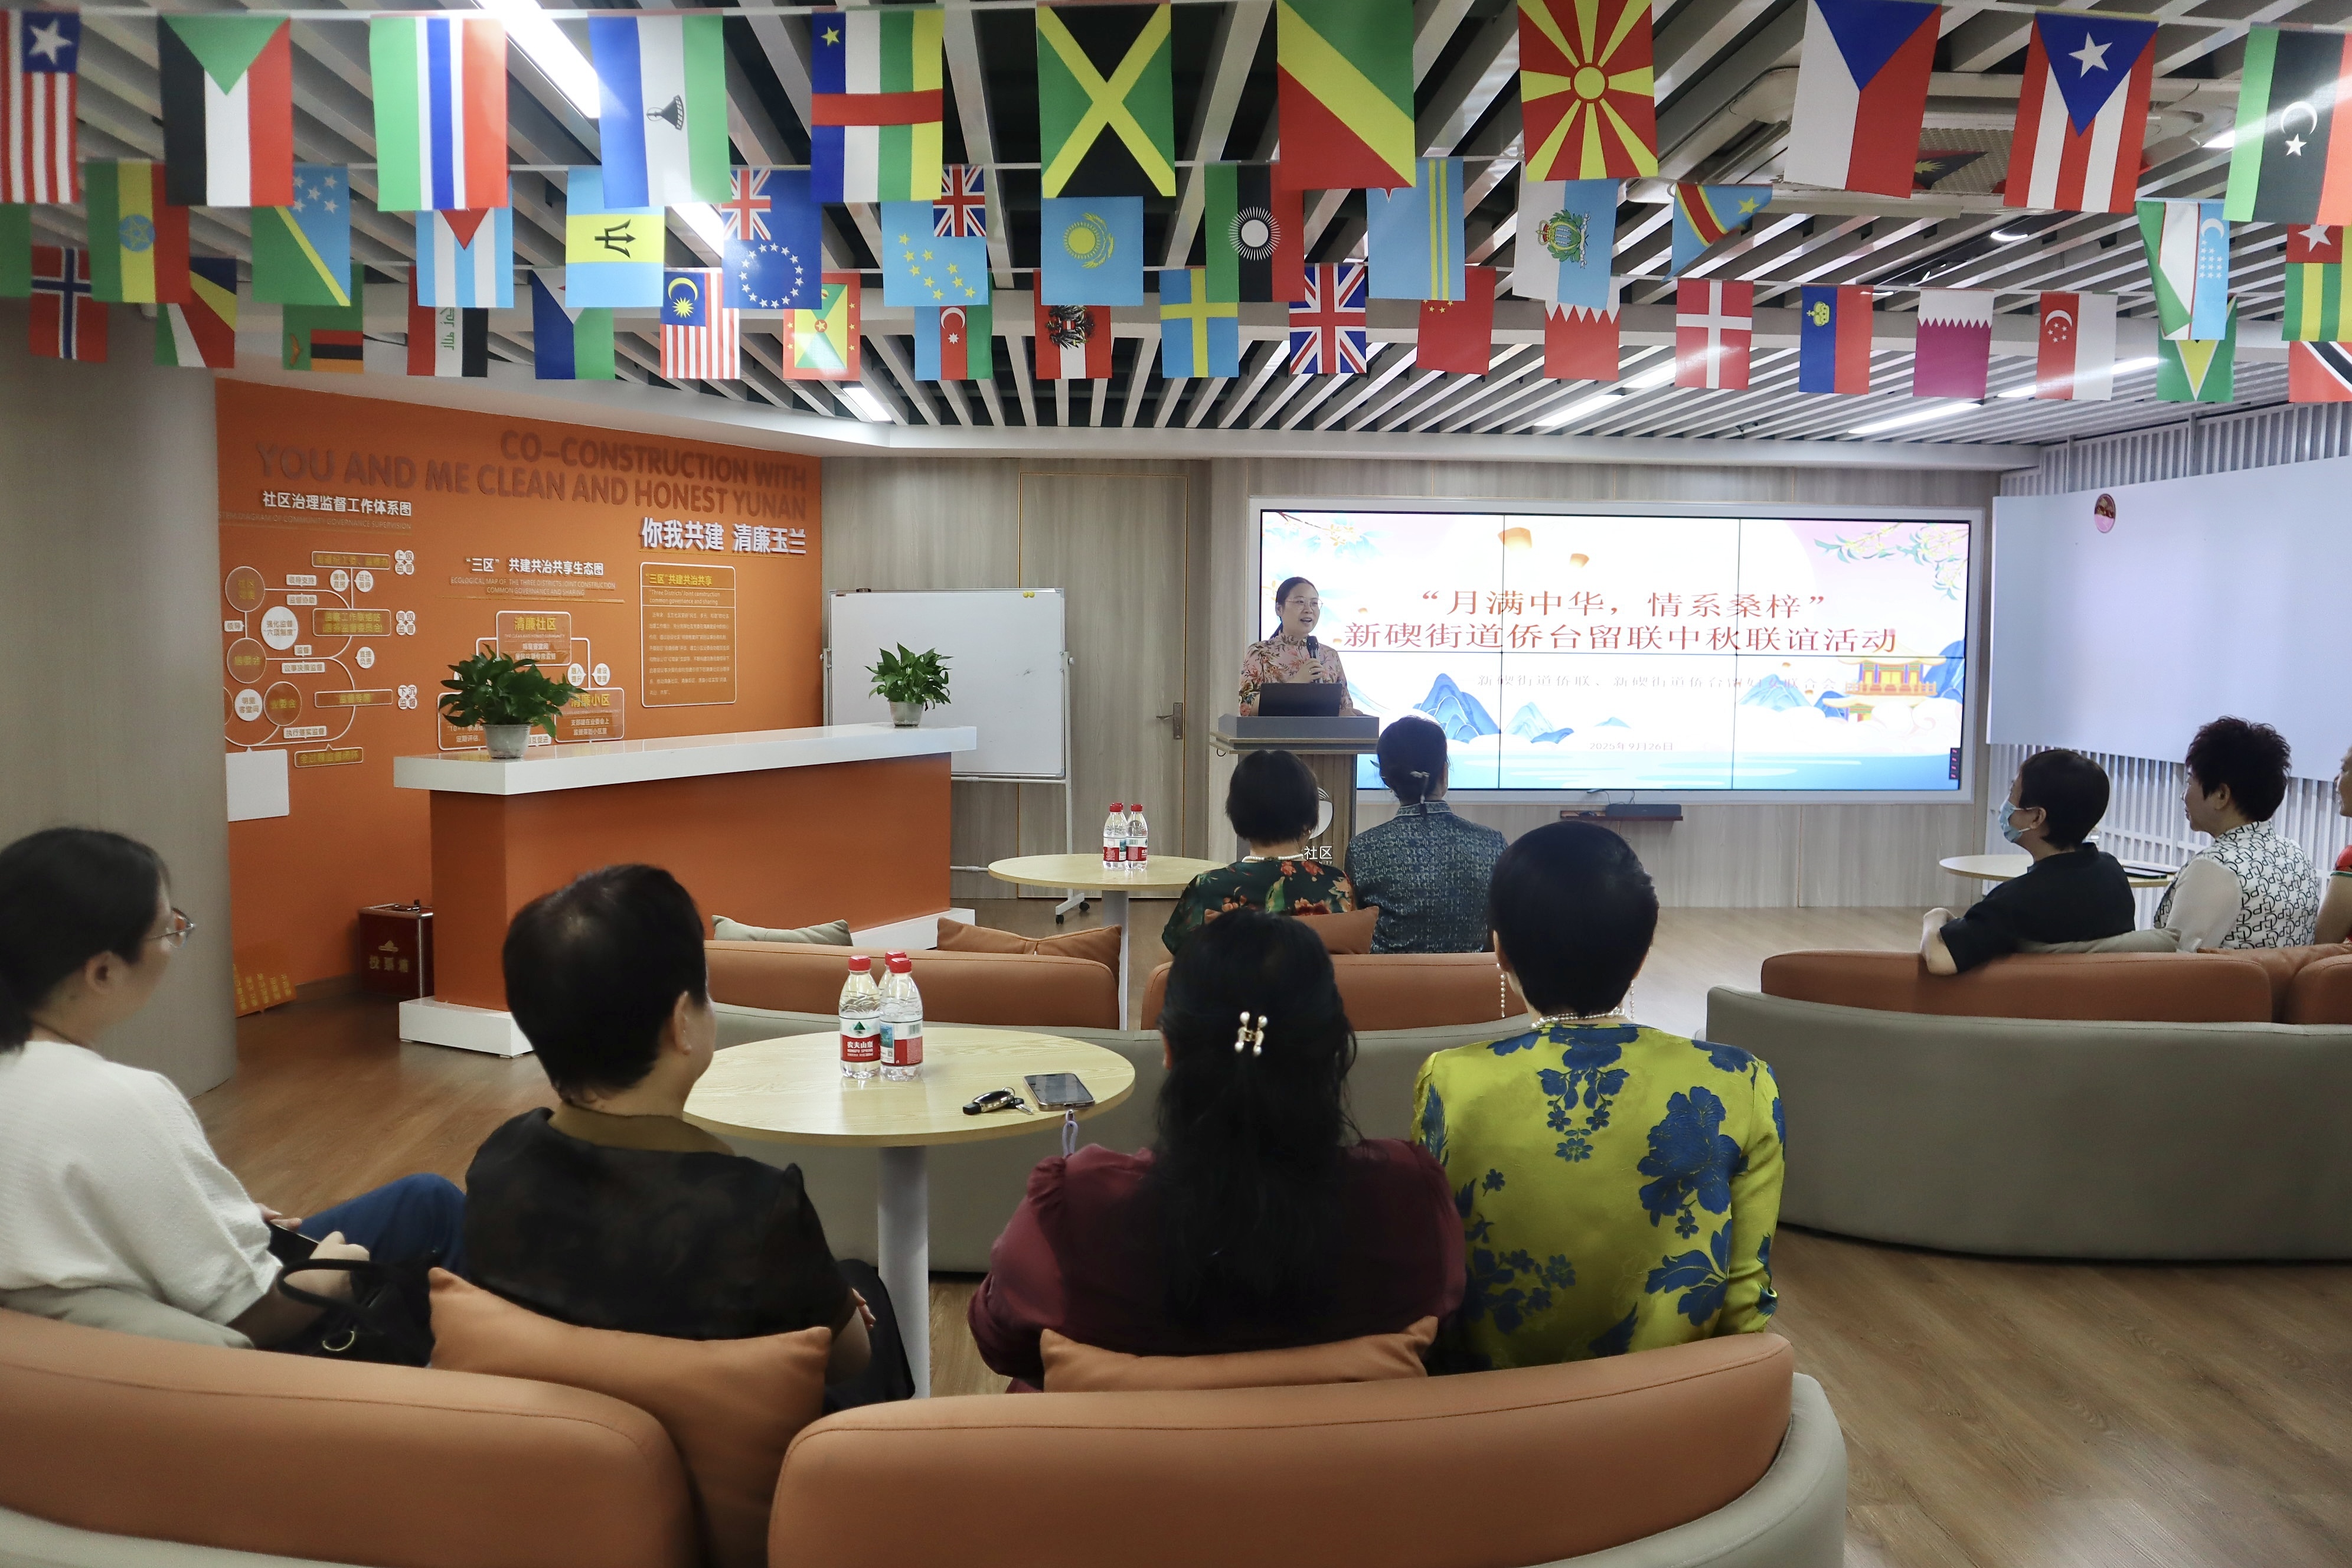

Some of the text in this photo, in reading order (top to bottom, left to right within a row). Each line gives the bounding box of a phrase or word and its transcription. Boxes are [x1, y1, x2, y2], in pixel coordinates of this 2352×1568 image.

[500, 430, 806, 492] CO-CONSTRUCTION WITH
[256, 442, 806, 521] YOU AND ME CLEAN AND HONEST YUNAN
[262, 491, 412, 517] 社区治理监督工作体系图
[641, 517, 806, 554] 你我共建 清廉玉兰
[509, 558, 604, 576] 共建共治共享生态图
[1422, 590, 1825, 619] “月满中华，情系桑梓”
[514, 616, 557, 631] 清廉社区
[1344, 622, 1896, 653] 新碶街道侨台留联中秋联谊活动
[1304, 845, 1332, 860] 社区
[368, 955, 410, 973] 投票箱
